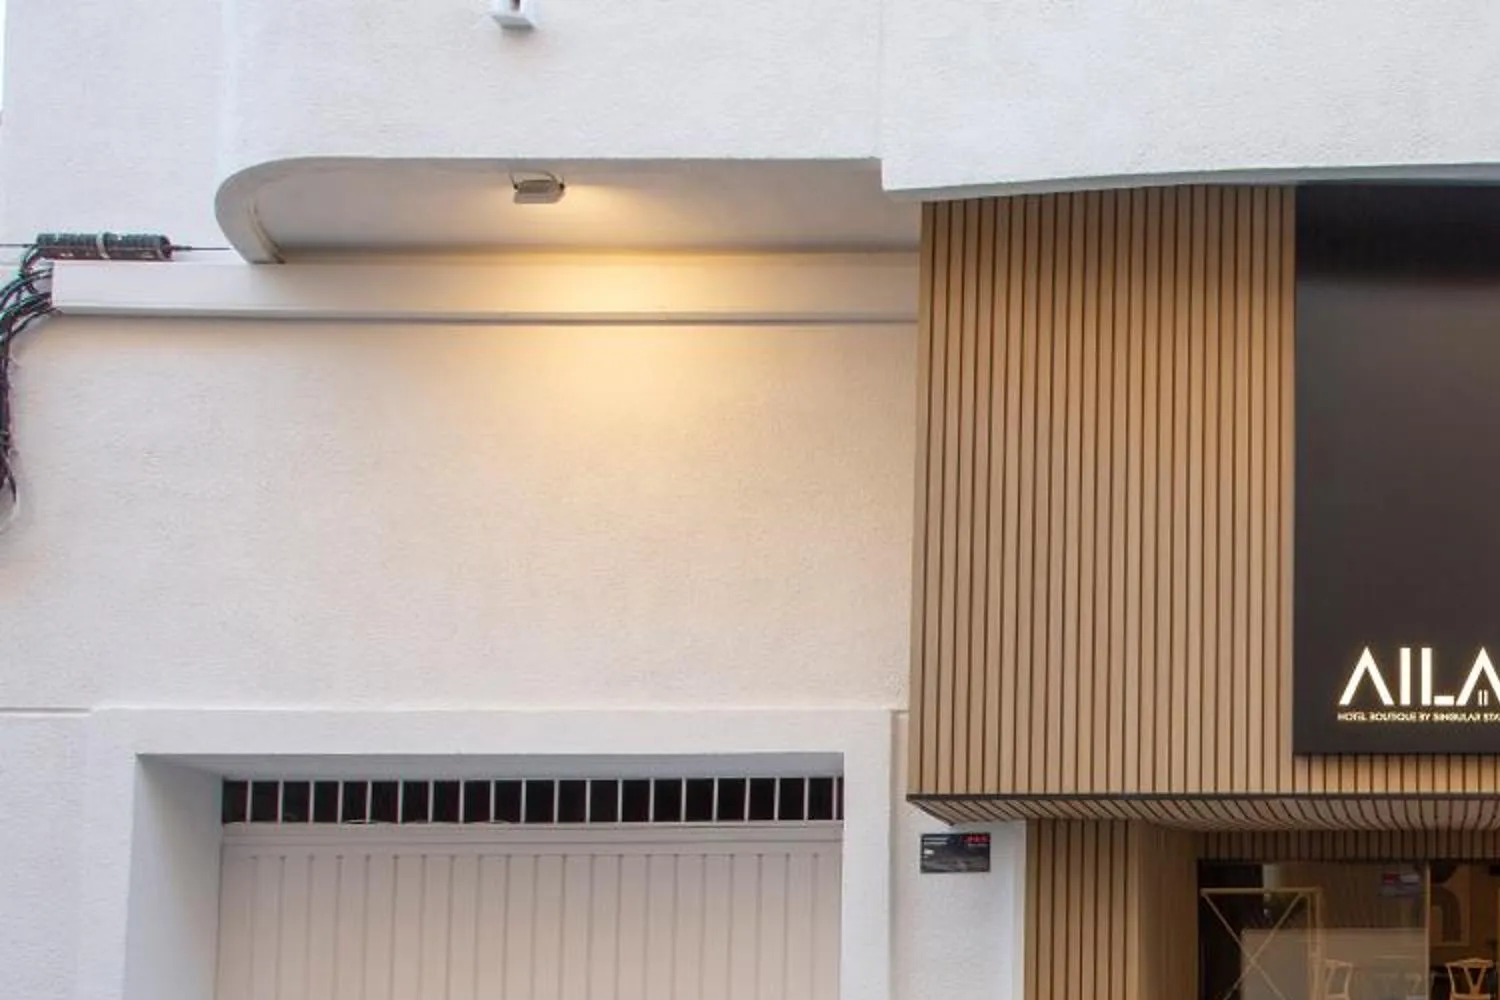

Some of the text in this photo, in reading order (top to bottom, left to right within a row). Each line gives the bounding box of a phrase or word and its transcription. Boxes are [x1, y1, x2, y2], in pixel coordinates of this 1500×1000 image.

[1337, 711, 1368, 722] HOTEL
[1369, 711, 1417, 722] BOUTIQUE
[1419, 712, 1431, 722] BY
